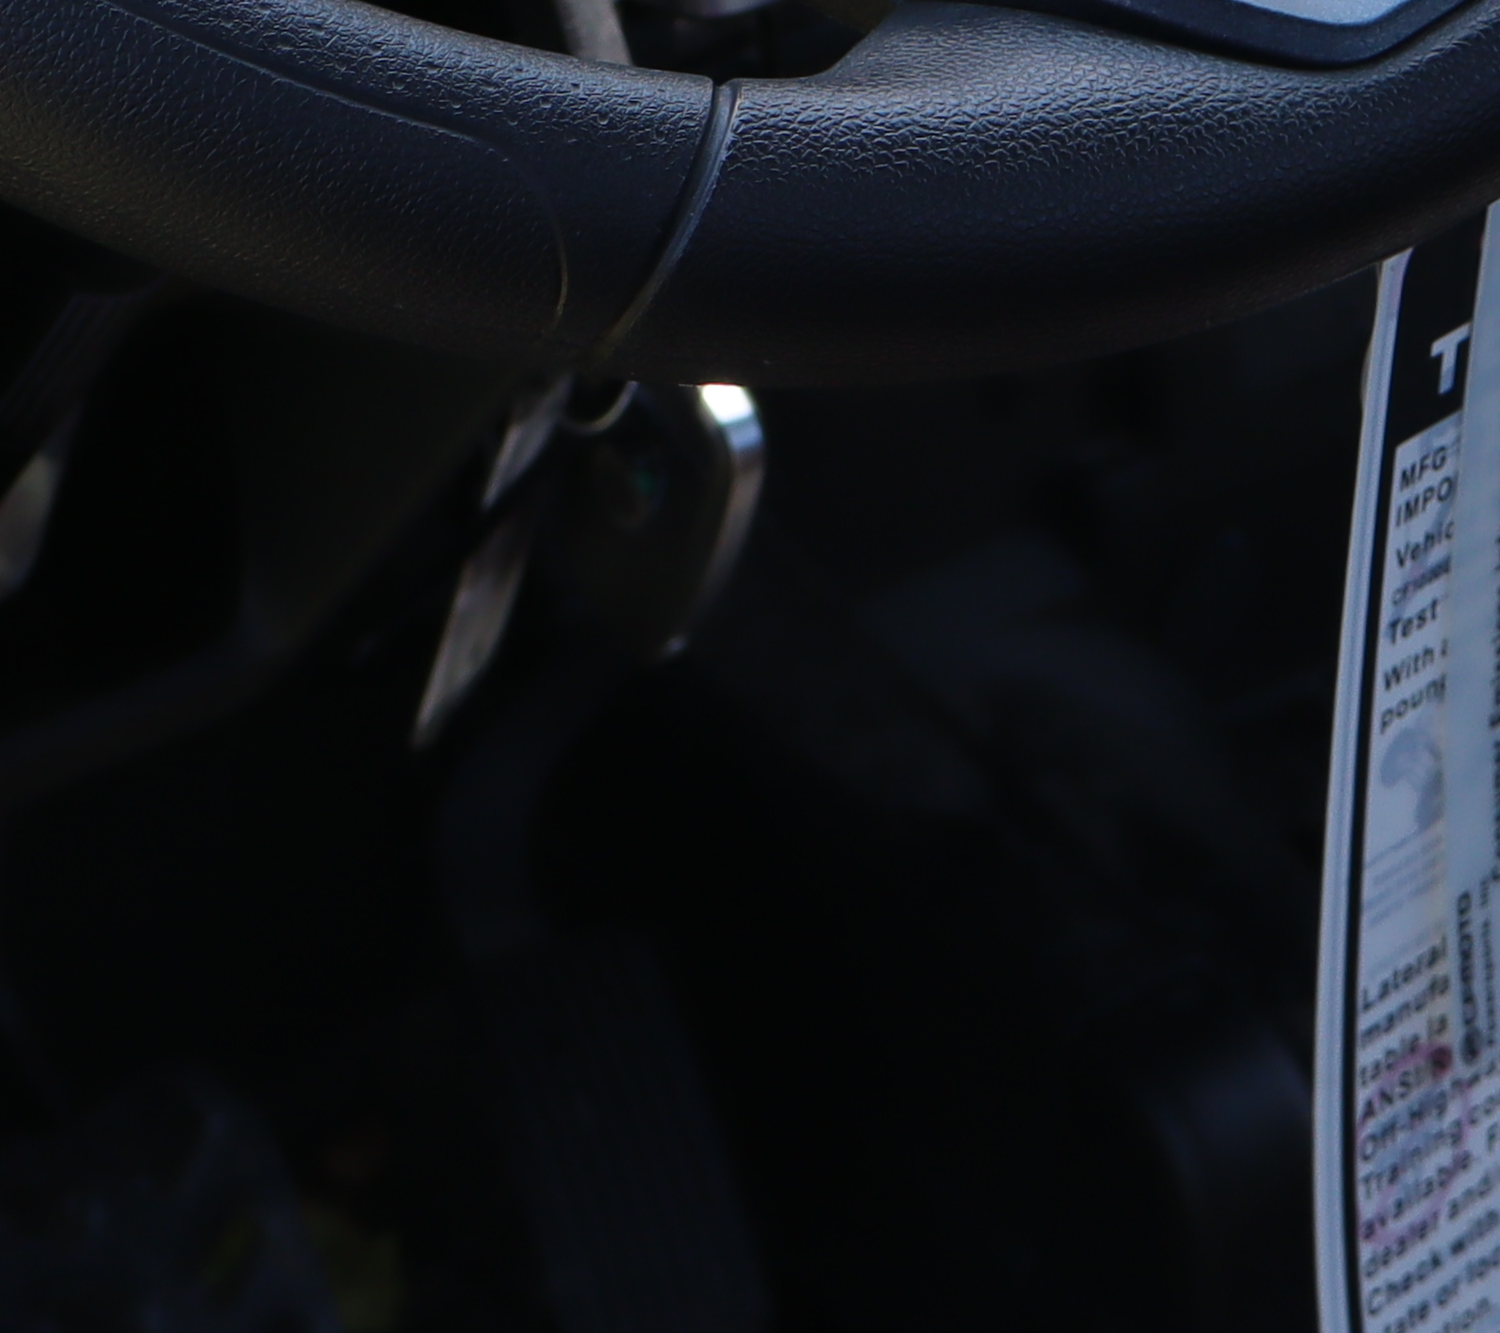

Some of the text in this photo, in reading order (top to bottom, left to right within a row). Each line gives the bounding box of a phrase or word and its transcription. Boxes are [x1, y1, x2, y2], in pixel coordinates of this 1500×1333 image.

[1400, 445, 1447, 490] MFG
[1387, 595, 1439, 645] Test
[1383, 647, 1435, 692] With
[1362, 936, 1446, 1011] Lateral
[1368, 1251, 1443, 1315] Check
